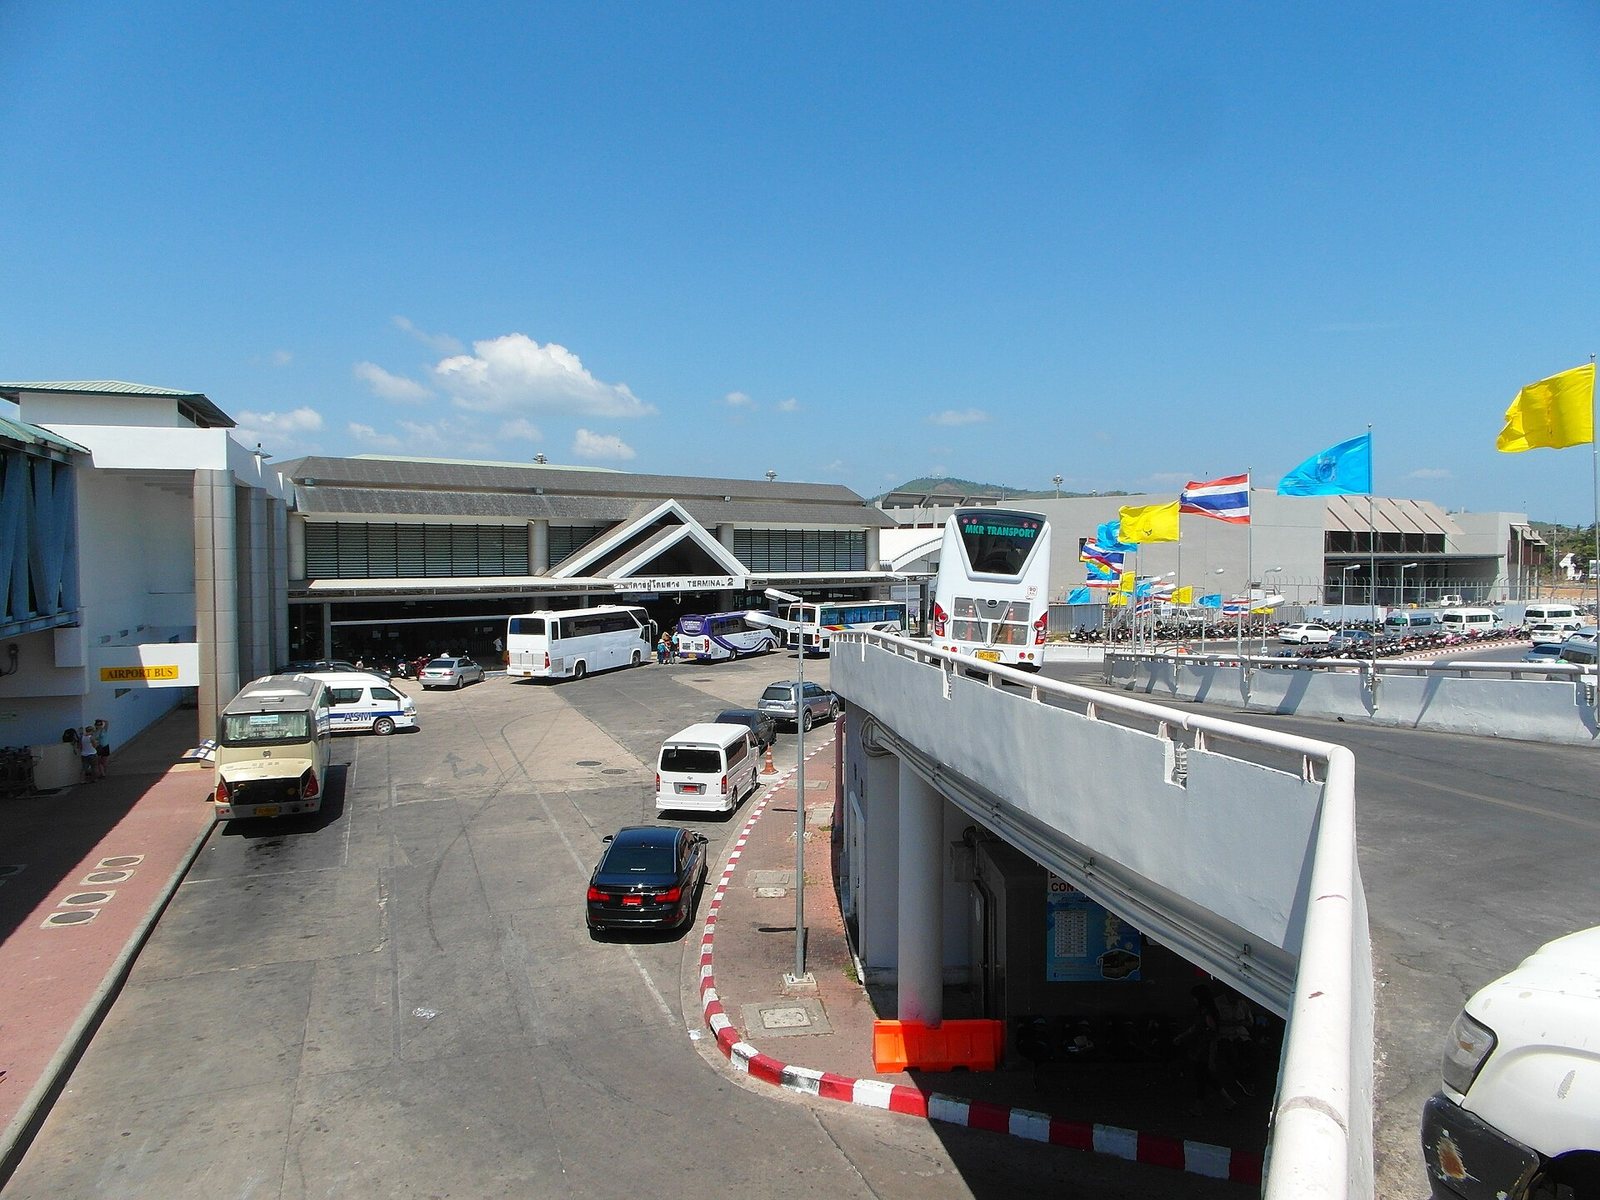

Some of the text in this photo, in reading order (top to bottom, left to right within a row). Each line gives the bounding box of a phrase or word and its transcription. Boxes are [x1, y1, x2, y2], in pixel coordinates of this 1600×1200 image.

[965, 525, 1035, 538] MKR TRANSPORT
[687, 580, 725, 588] TERMINAL
[727, 577, 734, 586] 2
[107, 667, 173, 679] AIRPORT BUS
[343, 711, 372, 722] ASM
